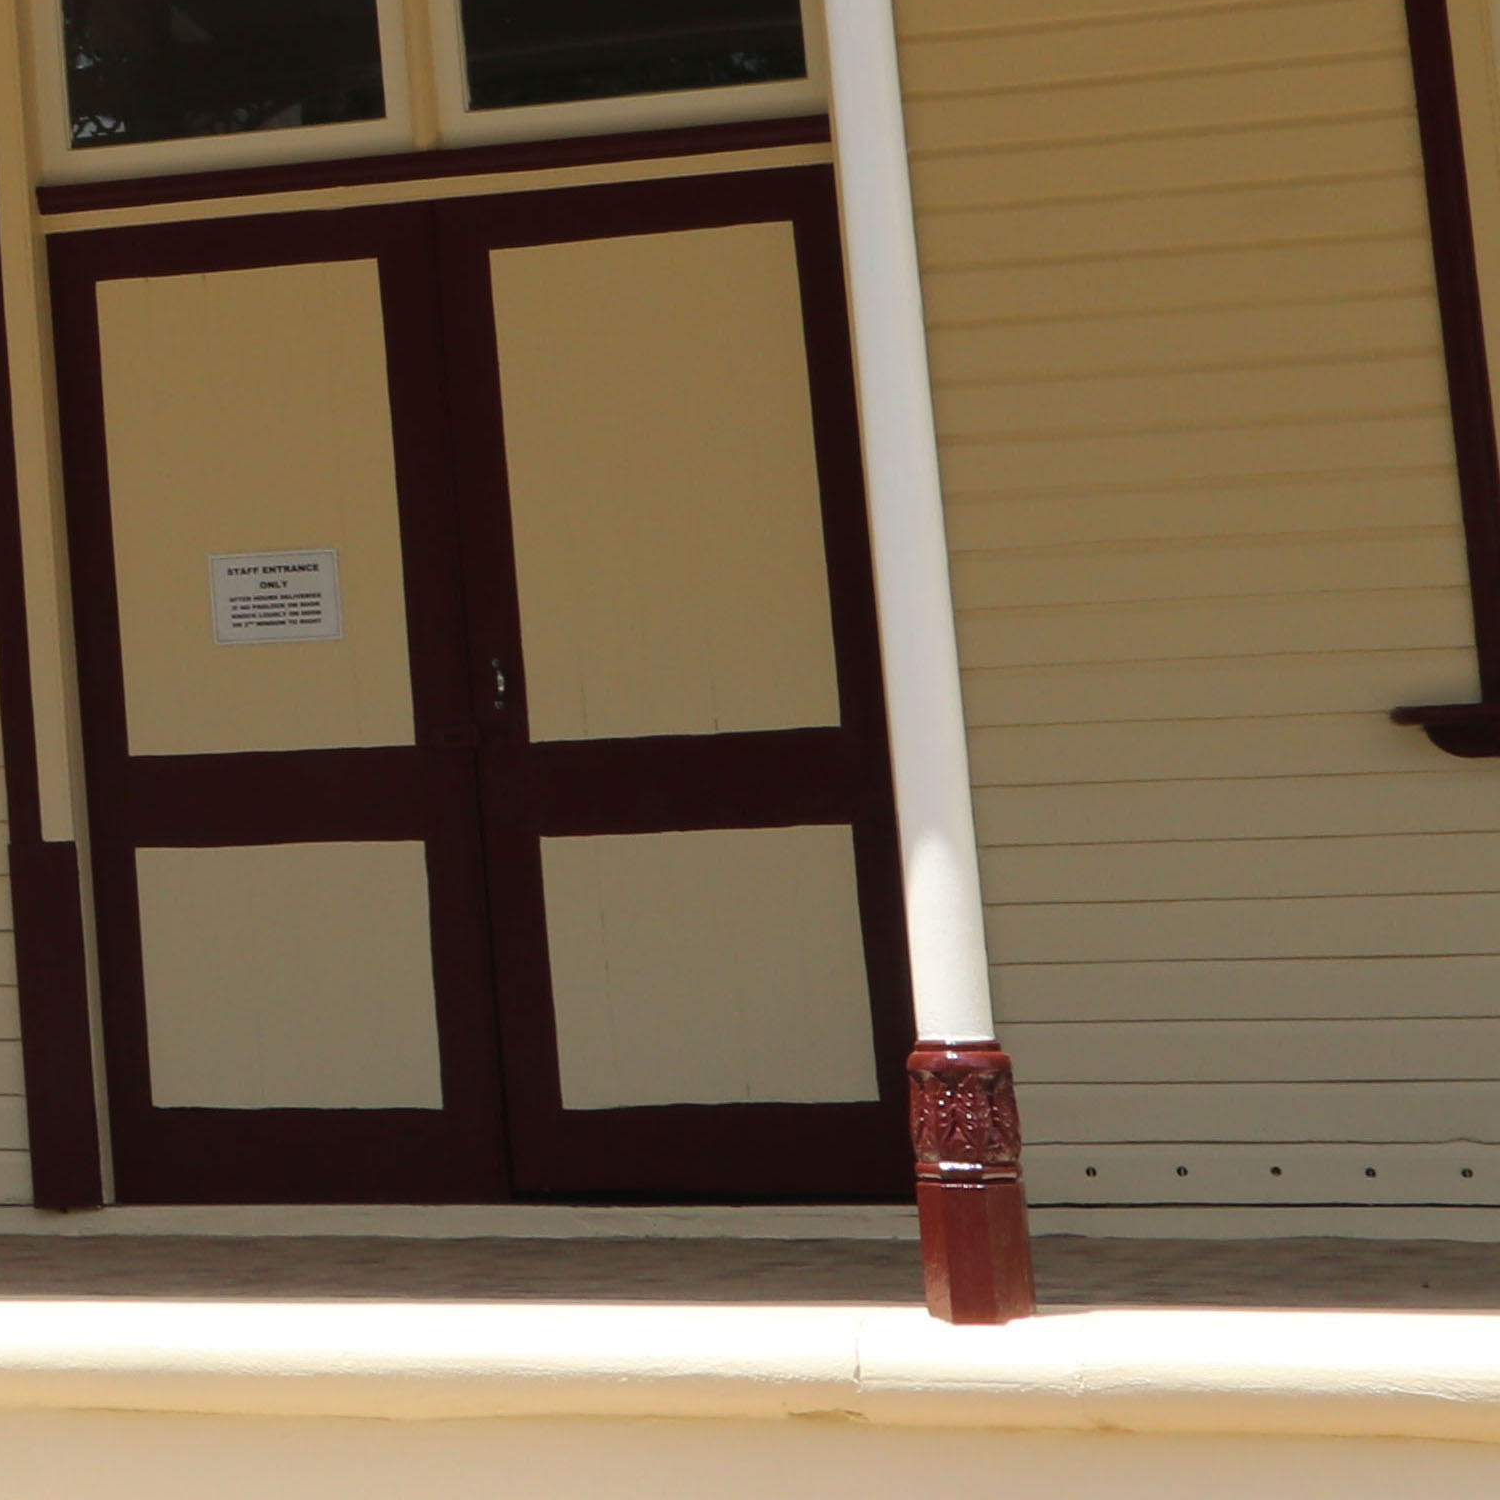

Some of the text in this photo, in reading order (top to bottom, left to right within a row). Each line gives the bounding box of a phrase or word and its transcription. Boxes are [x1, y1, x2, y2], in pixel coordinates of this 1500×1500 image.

[227, 564, 319, 575] STAFF ENTRANCE
[260, 581, 288, 589] ONLY
